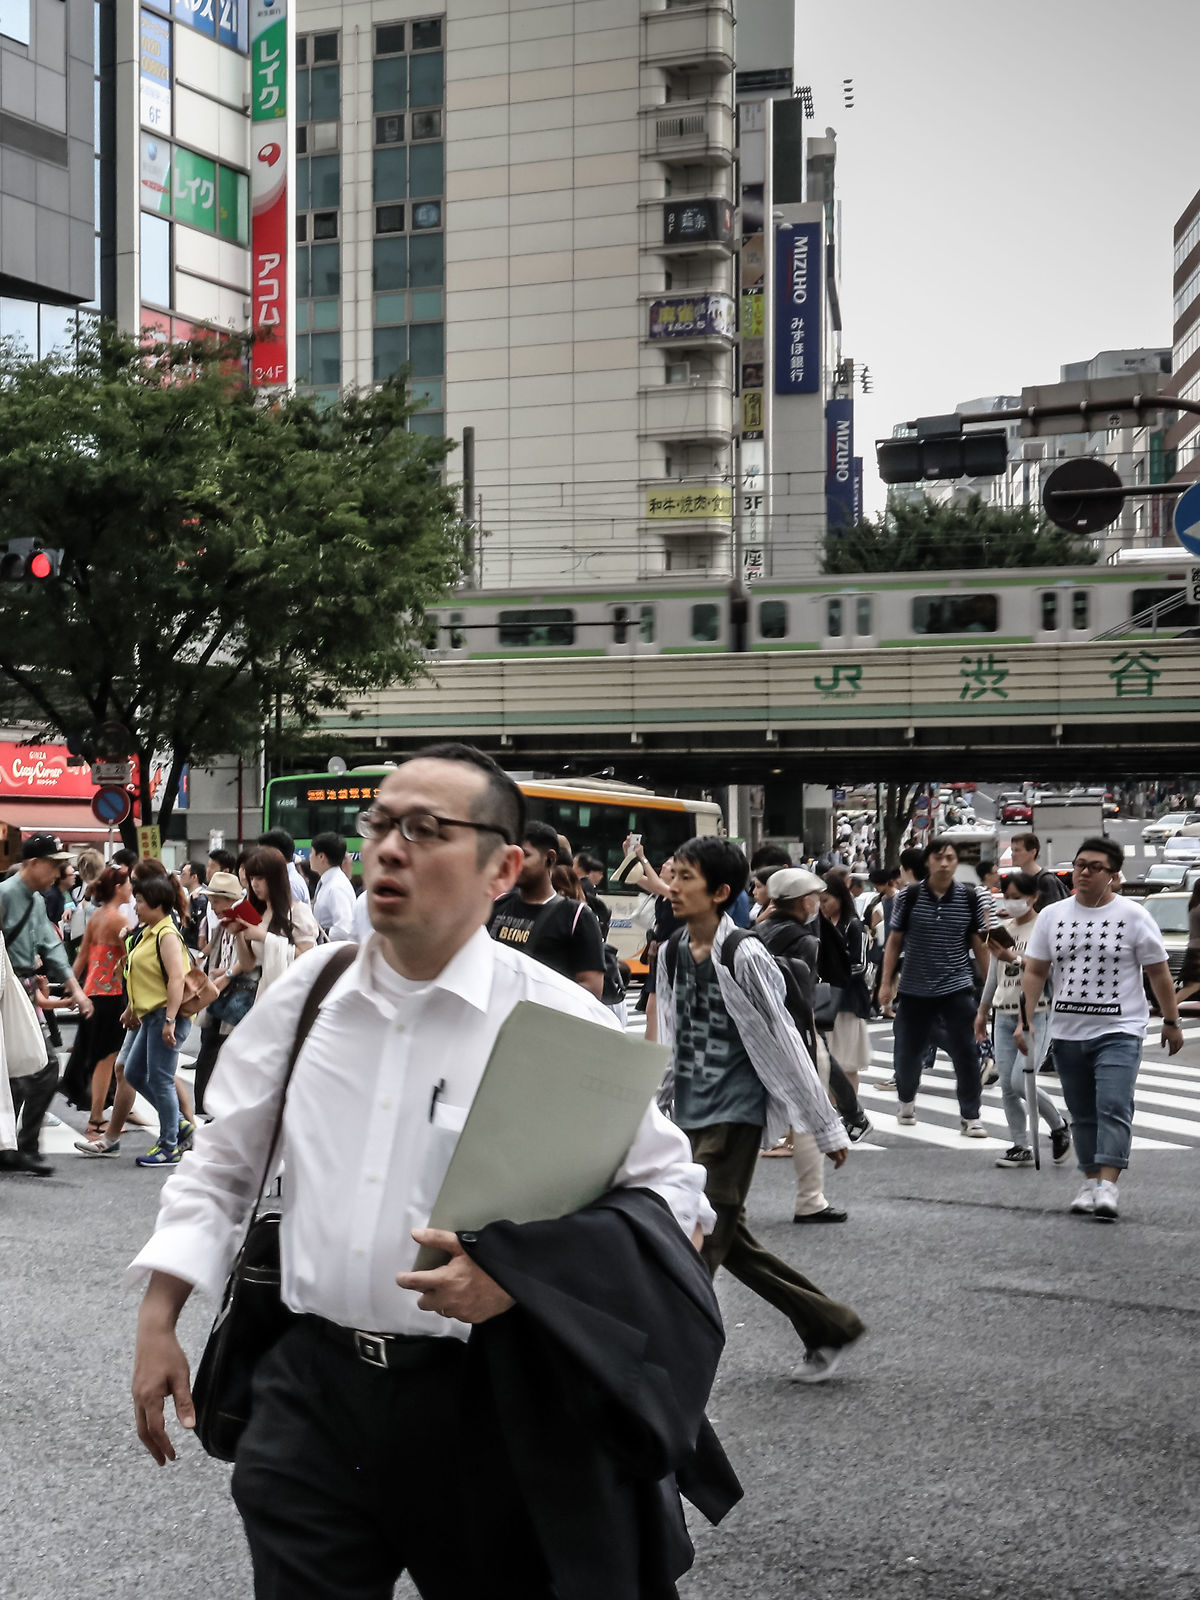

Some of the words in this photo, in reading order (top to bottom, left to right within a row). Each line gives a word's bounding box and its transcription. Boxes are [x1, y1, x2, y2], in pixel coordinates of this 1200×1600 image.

[258, 40, 281, 110] レイク
[149, 105, 161, 124] 6F
[174, 167, 215, 210] レイク
[258, 253, 280, 326] アコム
[793, 235, 809, 304] MIZUHO
[790, 317, 805, 382] みずほ銀行
[836, 420, 850, 482] MIZUHO
[743, 496, 763, 509] 3F
[814, 664, 862, 691] JR
[499, 926, 530, 943] BEING
